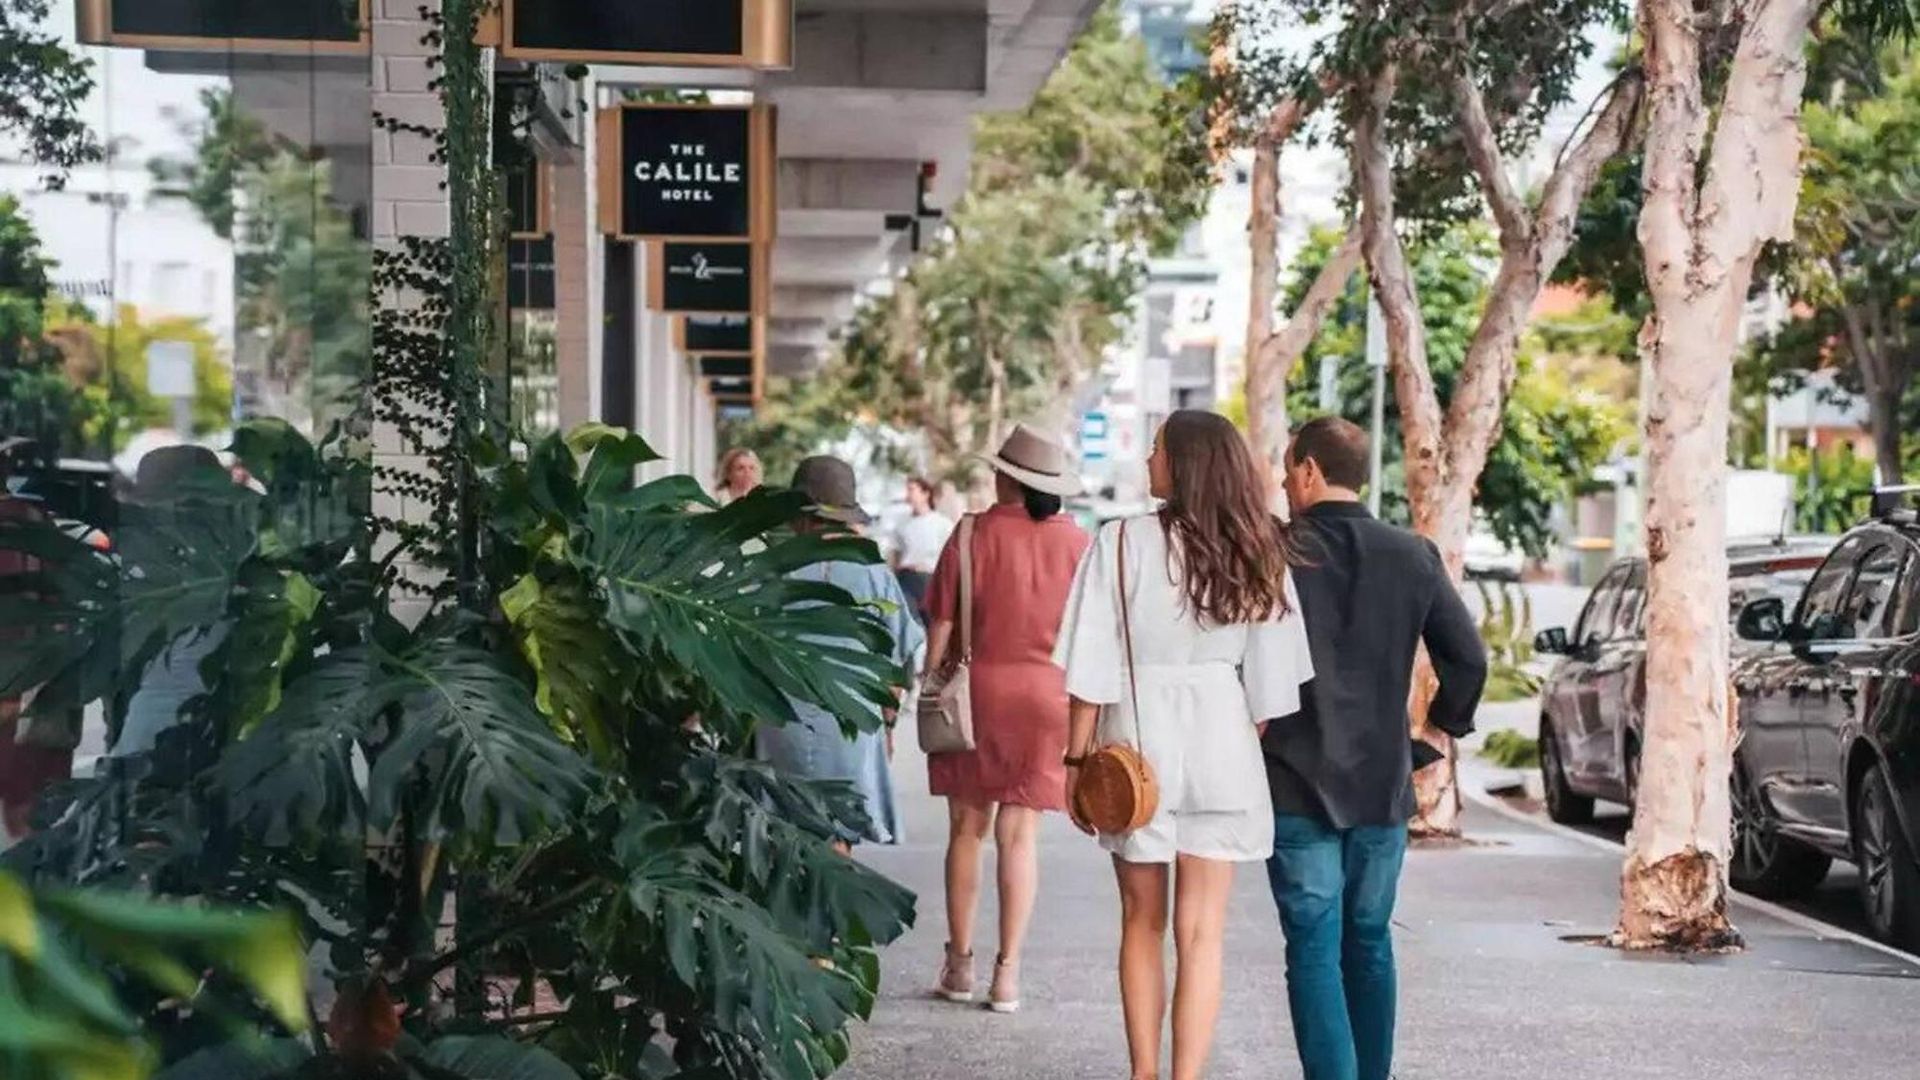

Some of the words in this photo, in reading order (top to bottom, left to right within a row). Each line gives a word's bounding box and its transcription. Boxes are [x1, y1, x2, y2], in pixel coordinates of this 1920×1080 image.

[670, 144, 705, 156] THE
[635, 162, 740, 181] CALILE
[661, 189, 713, 201] HOTEL
